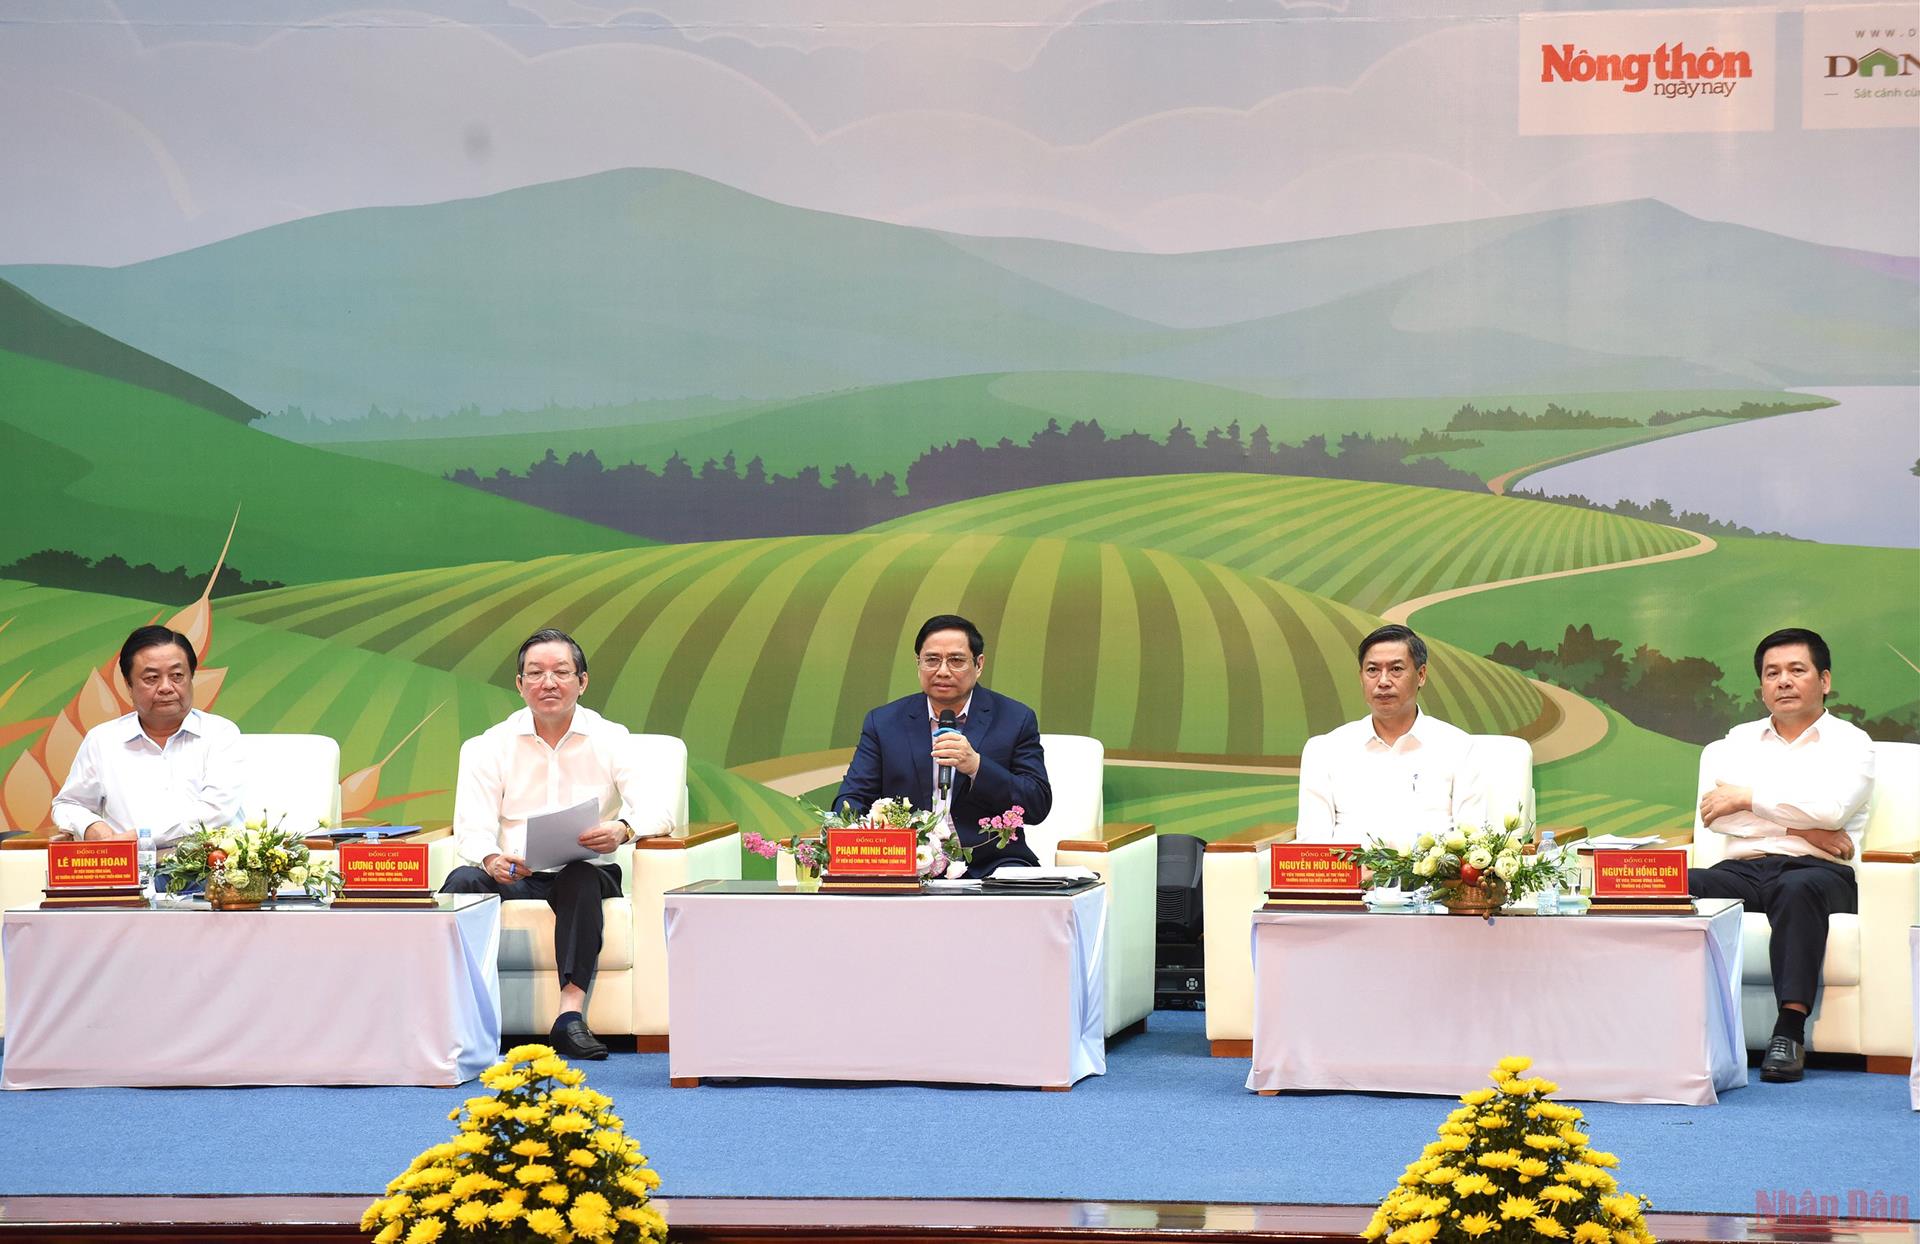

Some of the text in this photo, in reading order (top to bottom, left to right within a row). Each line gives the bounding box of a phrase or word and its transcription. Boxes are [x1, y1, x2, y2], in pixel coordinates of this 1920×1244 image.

[1541, 41, 1752, 93] Nông thôn
[1653, 79, 1737, 99] ngày nay
[836, 845, 906, 857] PHẠM MINH CHÍNH
[58, 857, 128, 867] LÊ MINH HOAN
[348, 858, 419, 871] LƯƠNG QUỐC ĐOÀN
[1280, 858, 1311, 870] NGUYỄN
[1313, 859, 1330, 870] HỮU
[1602, 864, 1634, 876] NGUYỄN
[1636, 865, 1658, 876] HỒNG
